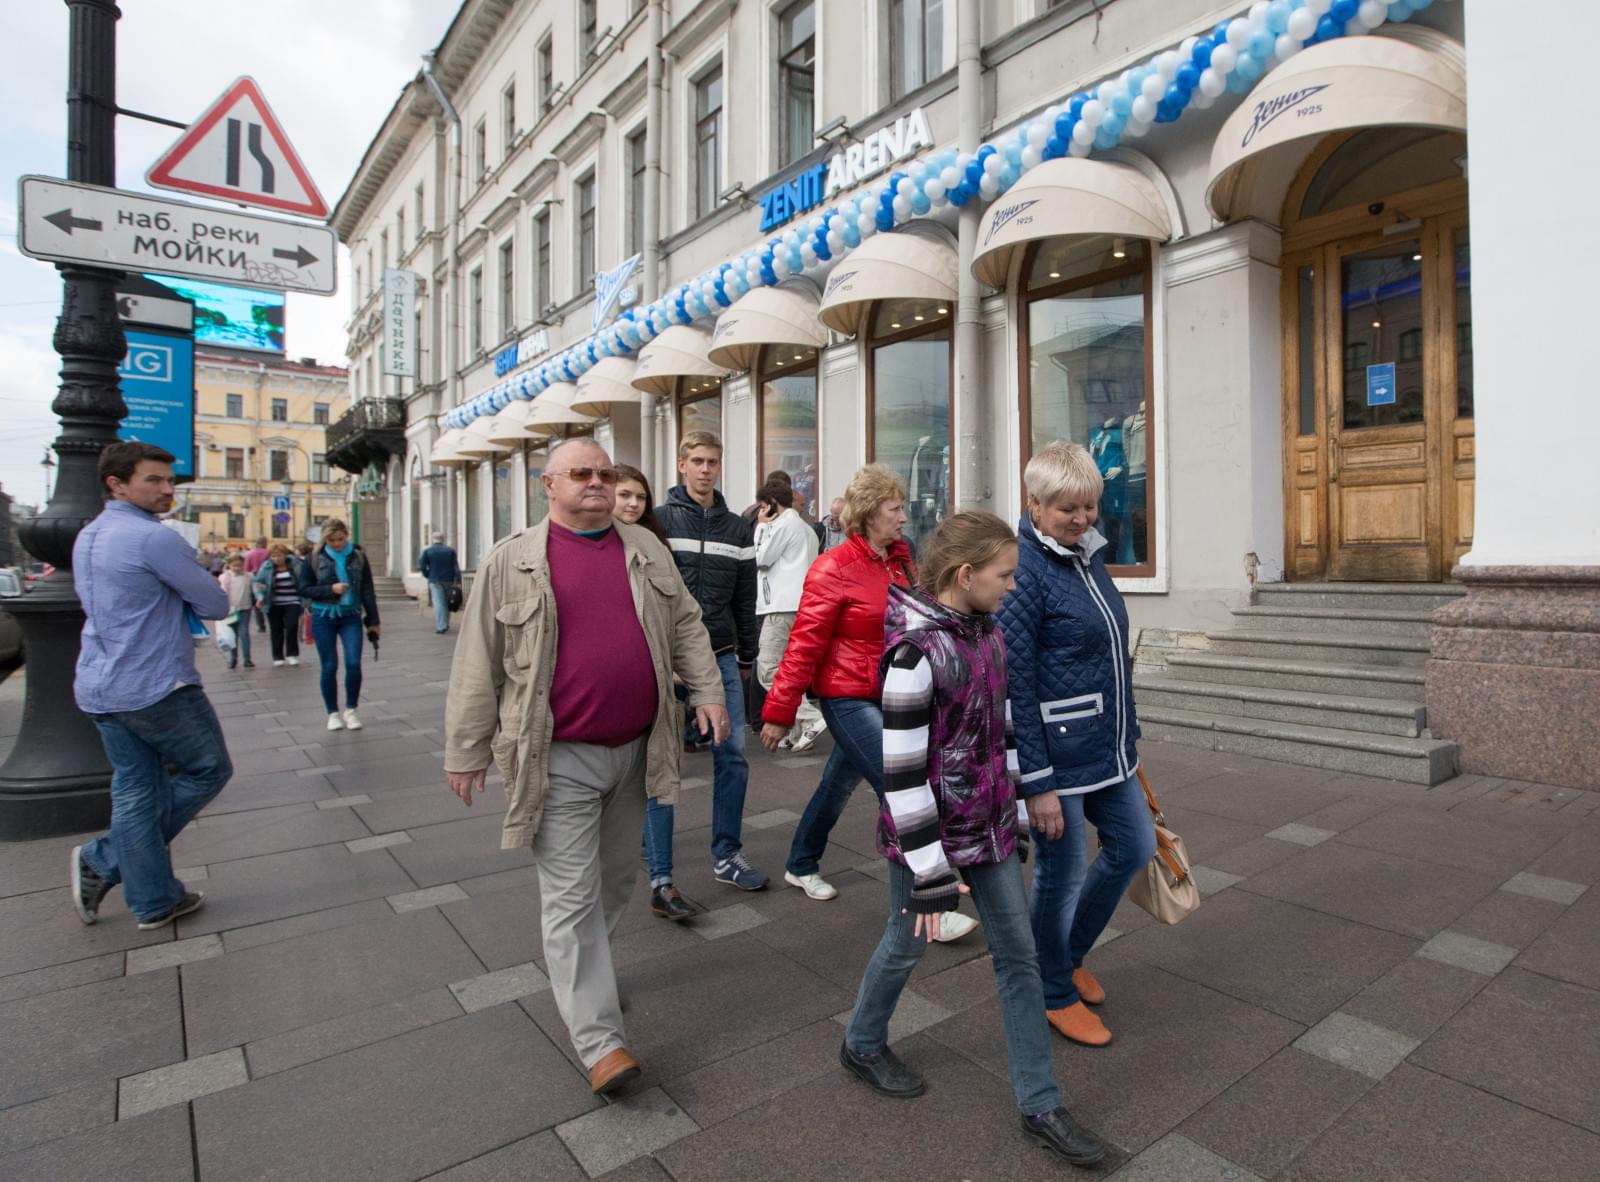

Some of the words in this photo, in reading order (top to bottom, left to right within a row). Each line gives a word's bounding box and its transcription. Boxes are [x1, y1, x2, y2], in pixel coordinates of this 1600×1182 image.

[1296, 104, 1322, 118] 1925
[758, 163, 828, 233] ZENIT
[824, 107, 934, 200] ARENA
[117, 209, 178, 233] наб.
[192, 221, 260, 246] реки
[133, 235, 248, 269] МОЙКИ
[115, 350, 161, 374] IG
